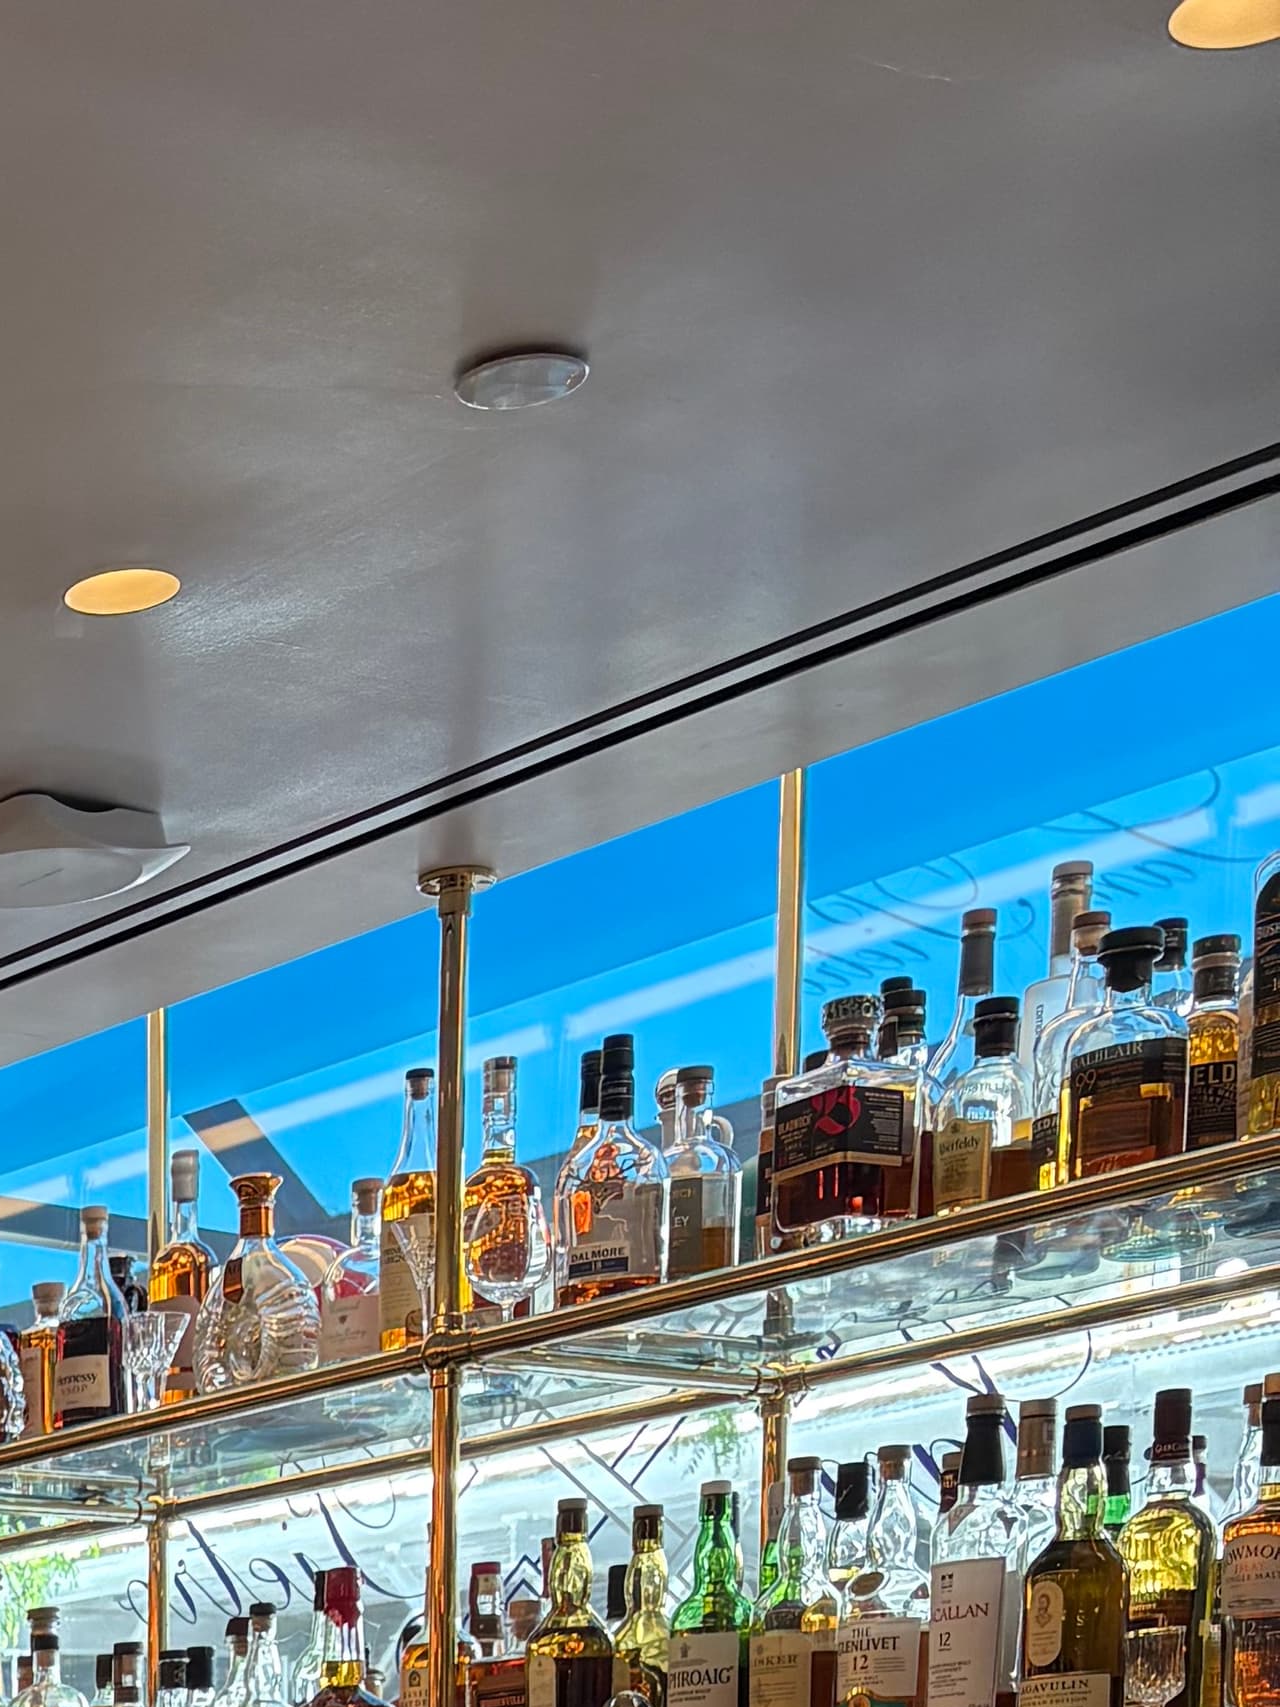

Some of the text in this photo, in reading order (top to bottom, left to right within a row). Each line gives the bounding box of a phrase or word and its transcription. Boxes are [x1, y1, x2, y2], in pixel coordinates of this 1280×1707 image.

[571, 1246, 626, 1263] DALMORE
[852, 1626, 871, 1638] THE
[939, 1631, 952, 1647] 12
[853, 1654, 869, 1671] 12
